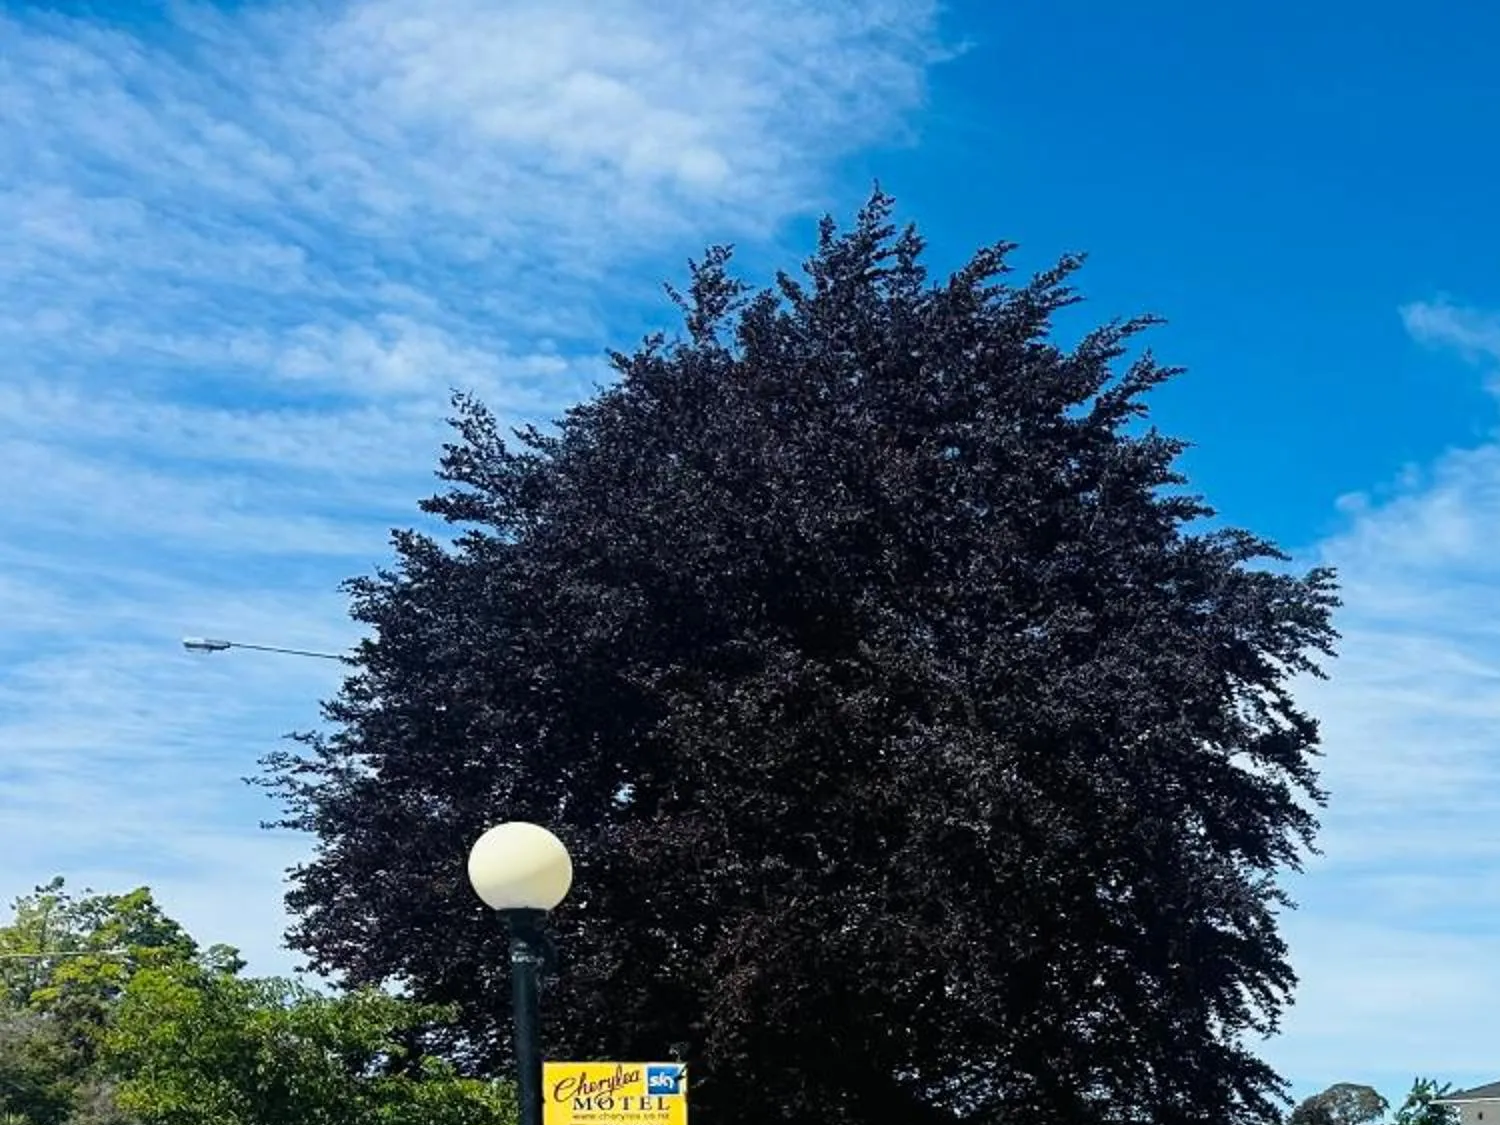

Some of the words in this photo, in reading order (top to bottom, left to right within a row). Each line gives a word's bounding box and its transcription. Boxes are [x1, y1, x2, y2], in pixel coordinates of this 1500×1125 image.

[553, 1064, 640, 1102] Cherylea
[649, 1072, 676, 1089] sky
[572, 1096, 671, 1111] MOTEL
